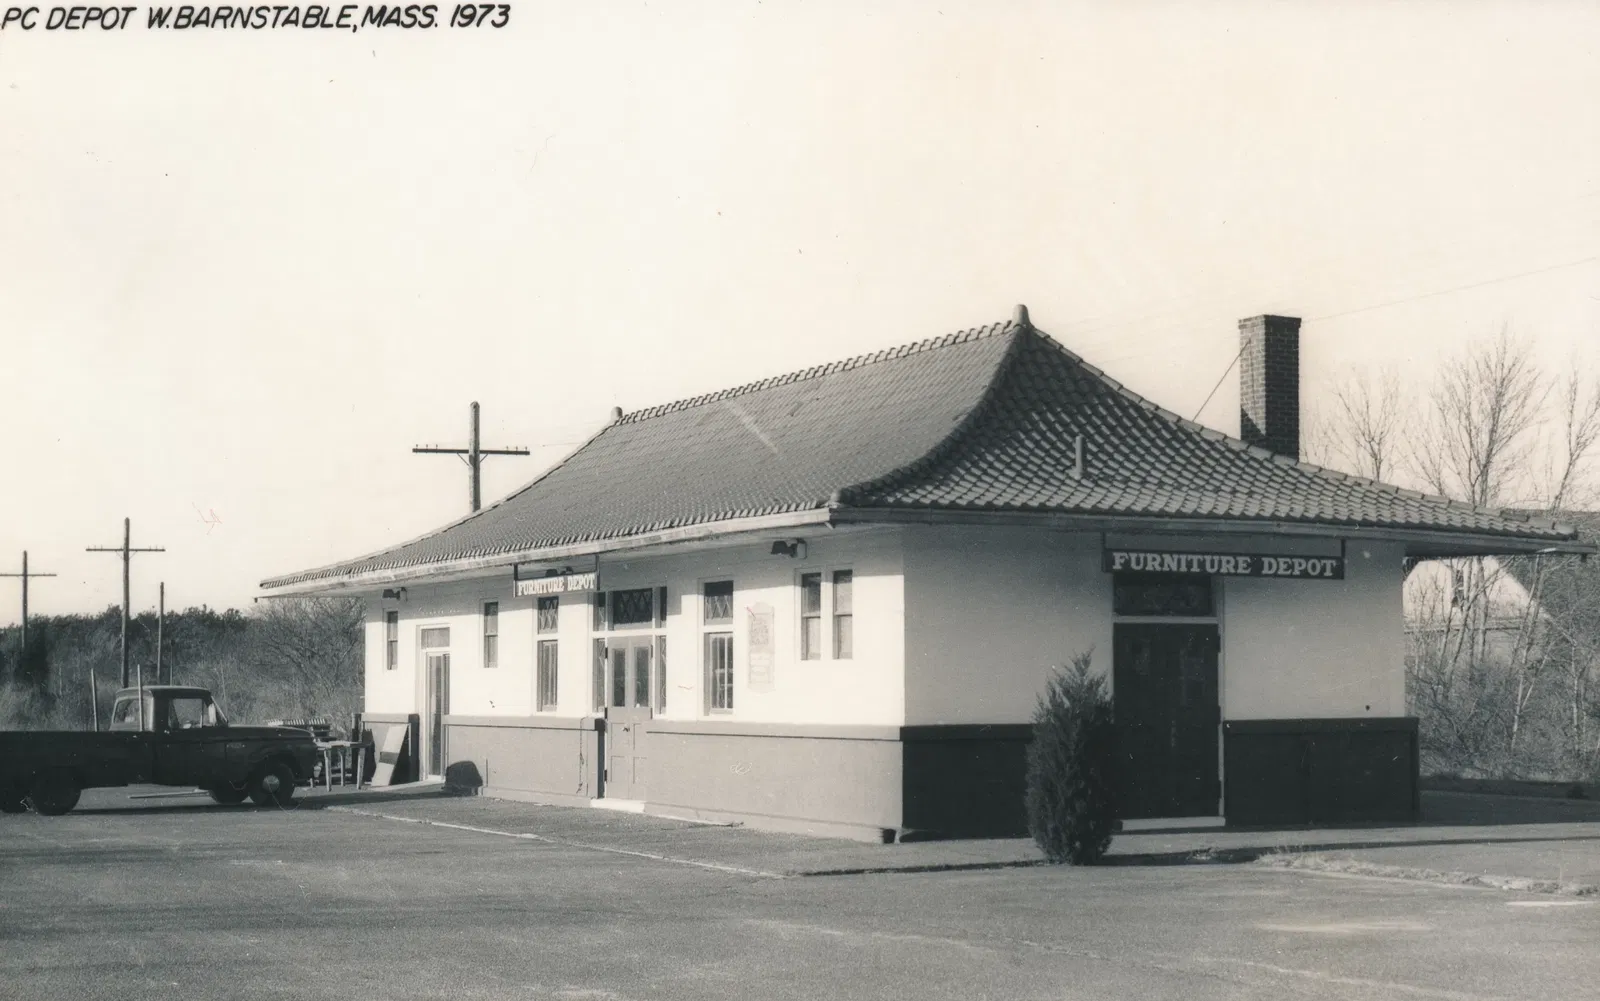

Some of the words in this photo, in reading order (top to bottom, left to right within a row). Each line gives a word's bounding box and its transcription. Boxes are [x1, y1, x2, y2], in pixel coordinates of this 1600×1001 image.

[1112, 552, 1251, 574] FURNITURE
[1261, 557, 1337, 577] DEPOT
[517, 577, 565, 596] FURNITURE
[567, 574, 595, 591] DEPOT
